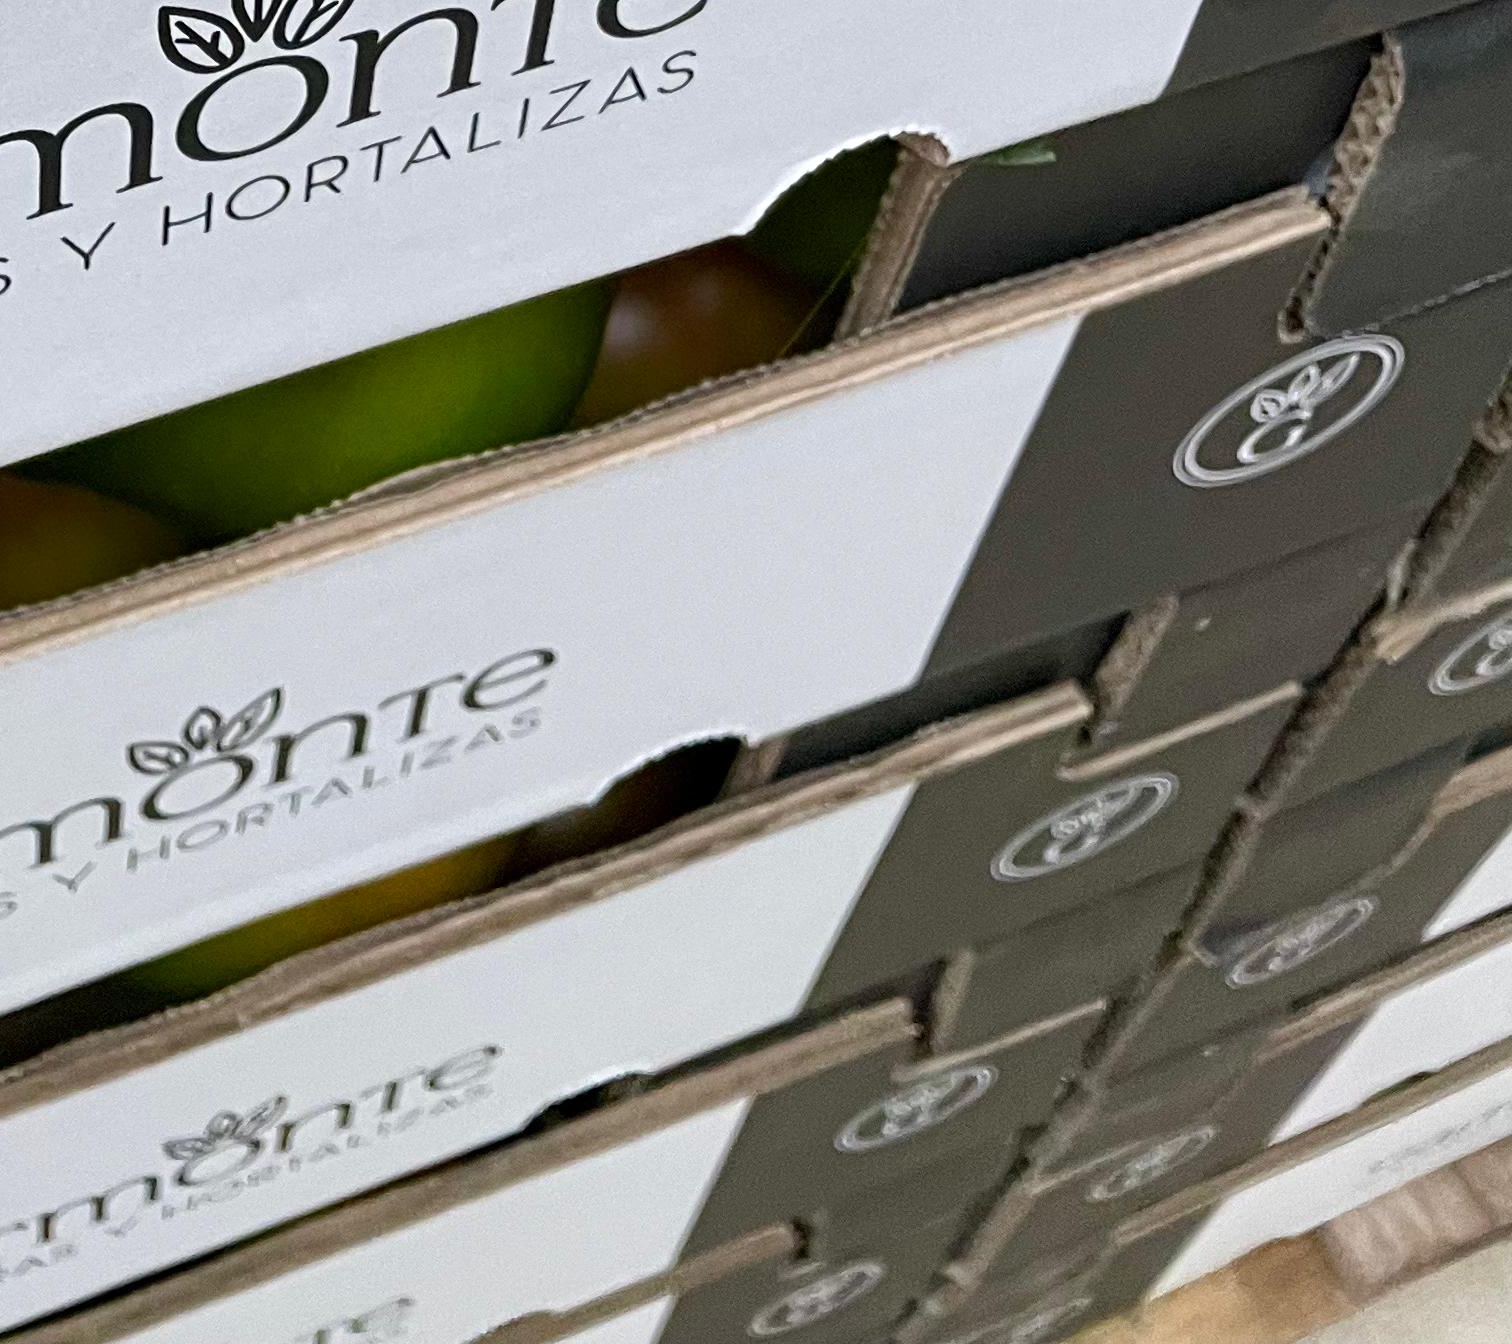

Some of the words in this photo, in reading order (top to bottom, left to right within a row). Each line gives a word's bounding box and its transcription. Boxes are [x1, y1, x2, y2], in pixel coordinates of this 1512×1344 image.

[61, 220, 120, 272] Y
[160, 48, 702, 248] HORTALIZAS
[51, 858, 100, 896] Y
[125, 704, 546, 874] HORTALIZAS
